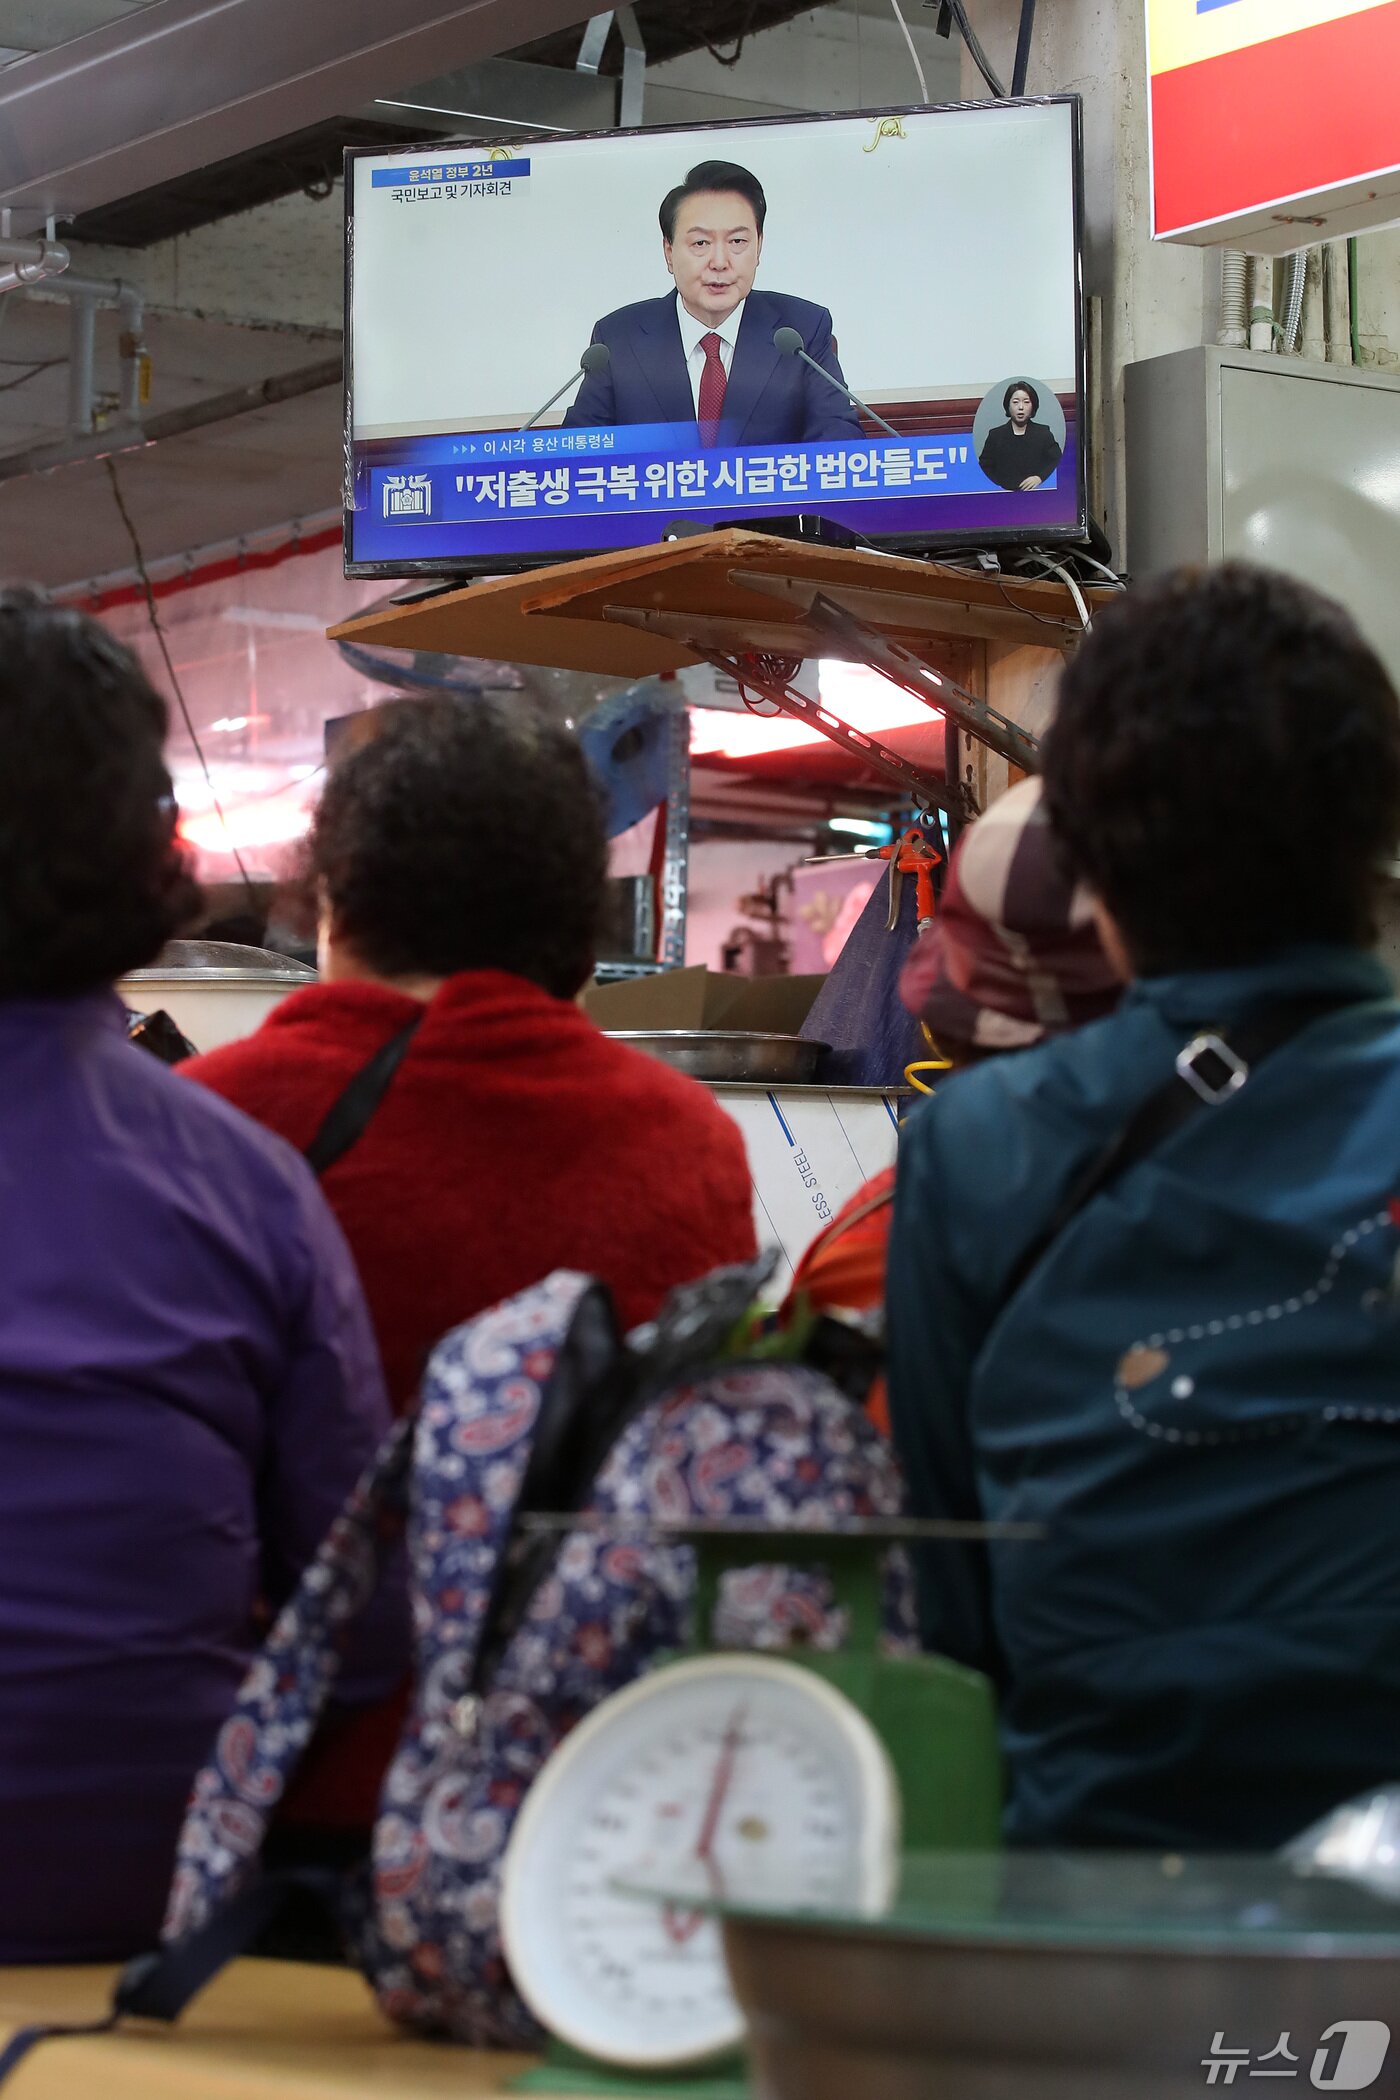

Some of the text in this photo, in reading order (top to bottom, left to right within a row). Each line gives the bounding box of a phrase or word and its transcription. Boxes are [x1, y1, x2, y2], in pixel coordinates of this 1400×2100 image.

[408, 164, 493, 182] 윤석열 정부 2년
[391, 180, 511, 203] 국민보고 및 기자회견
[484, 433, 615, 455] 이 시각 용산 대통령실
[455, 446, 968, 509] "저출생 극복 위한 시급한 법안들도"
[793, 1147, 818, 1189] STEEL
